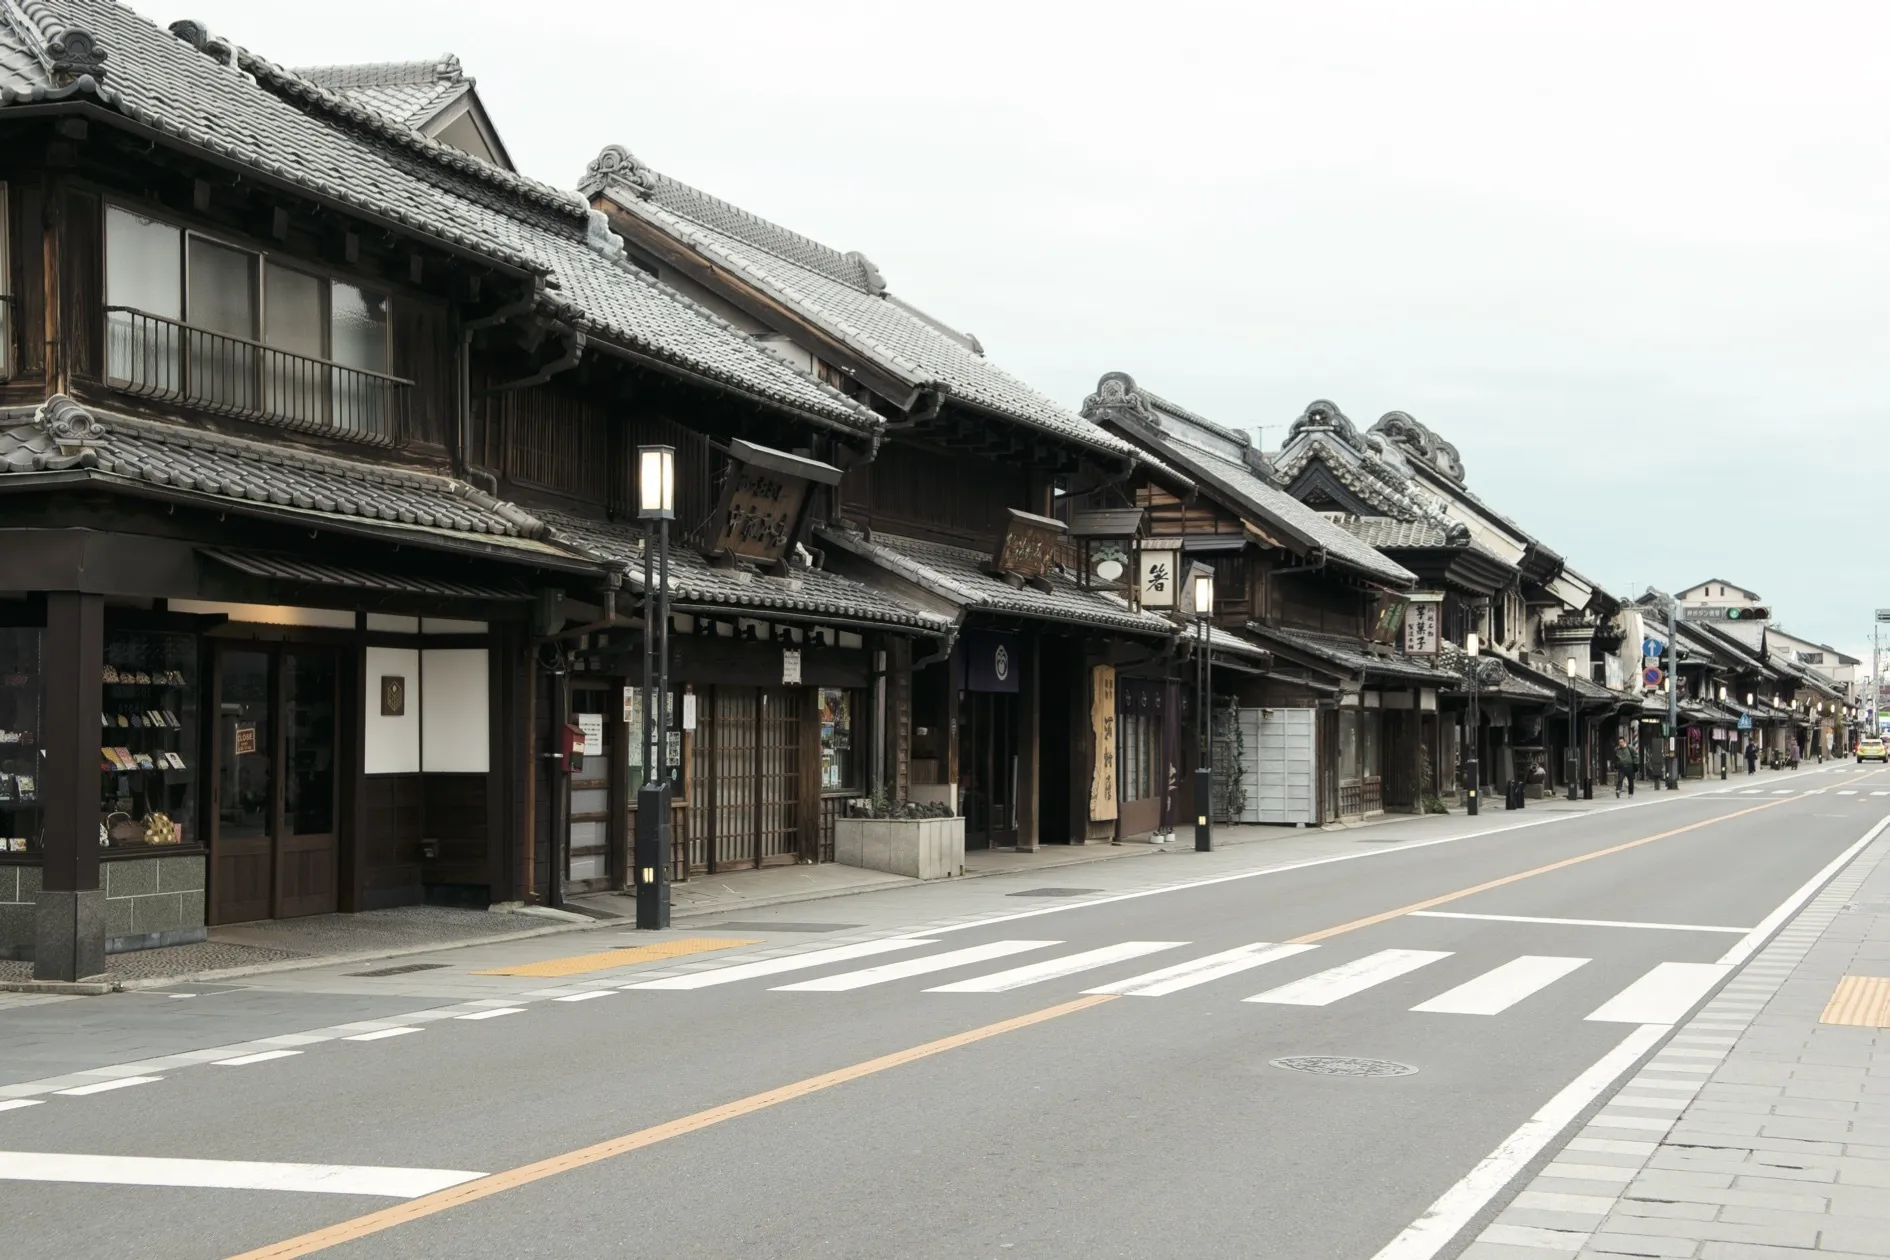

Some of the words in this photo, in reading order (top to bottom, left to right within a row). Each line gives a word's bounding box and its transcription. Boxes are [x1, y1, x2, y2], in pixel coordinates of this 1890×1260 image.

[1146, 563, 1169, 592] 箸
[1416, 604, 1427, 650] 芋菓子
[238, 733, 253, 742] CLOSE
